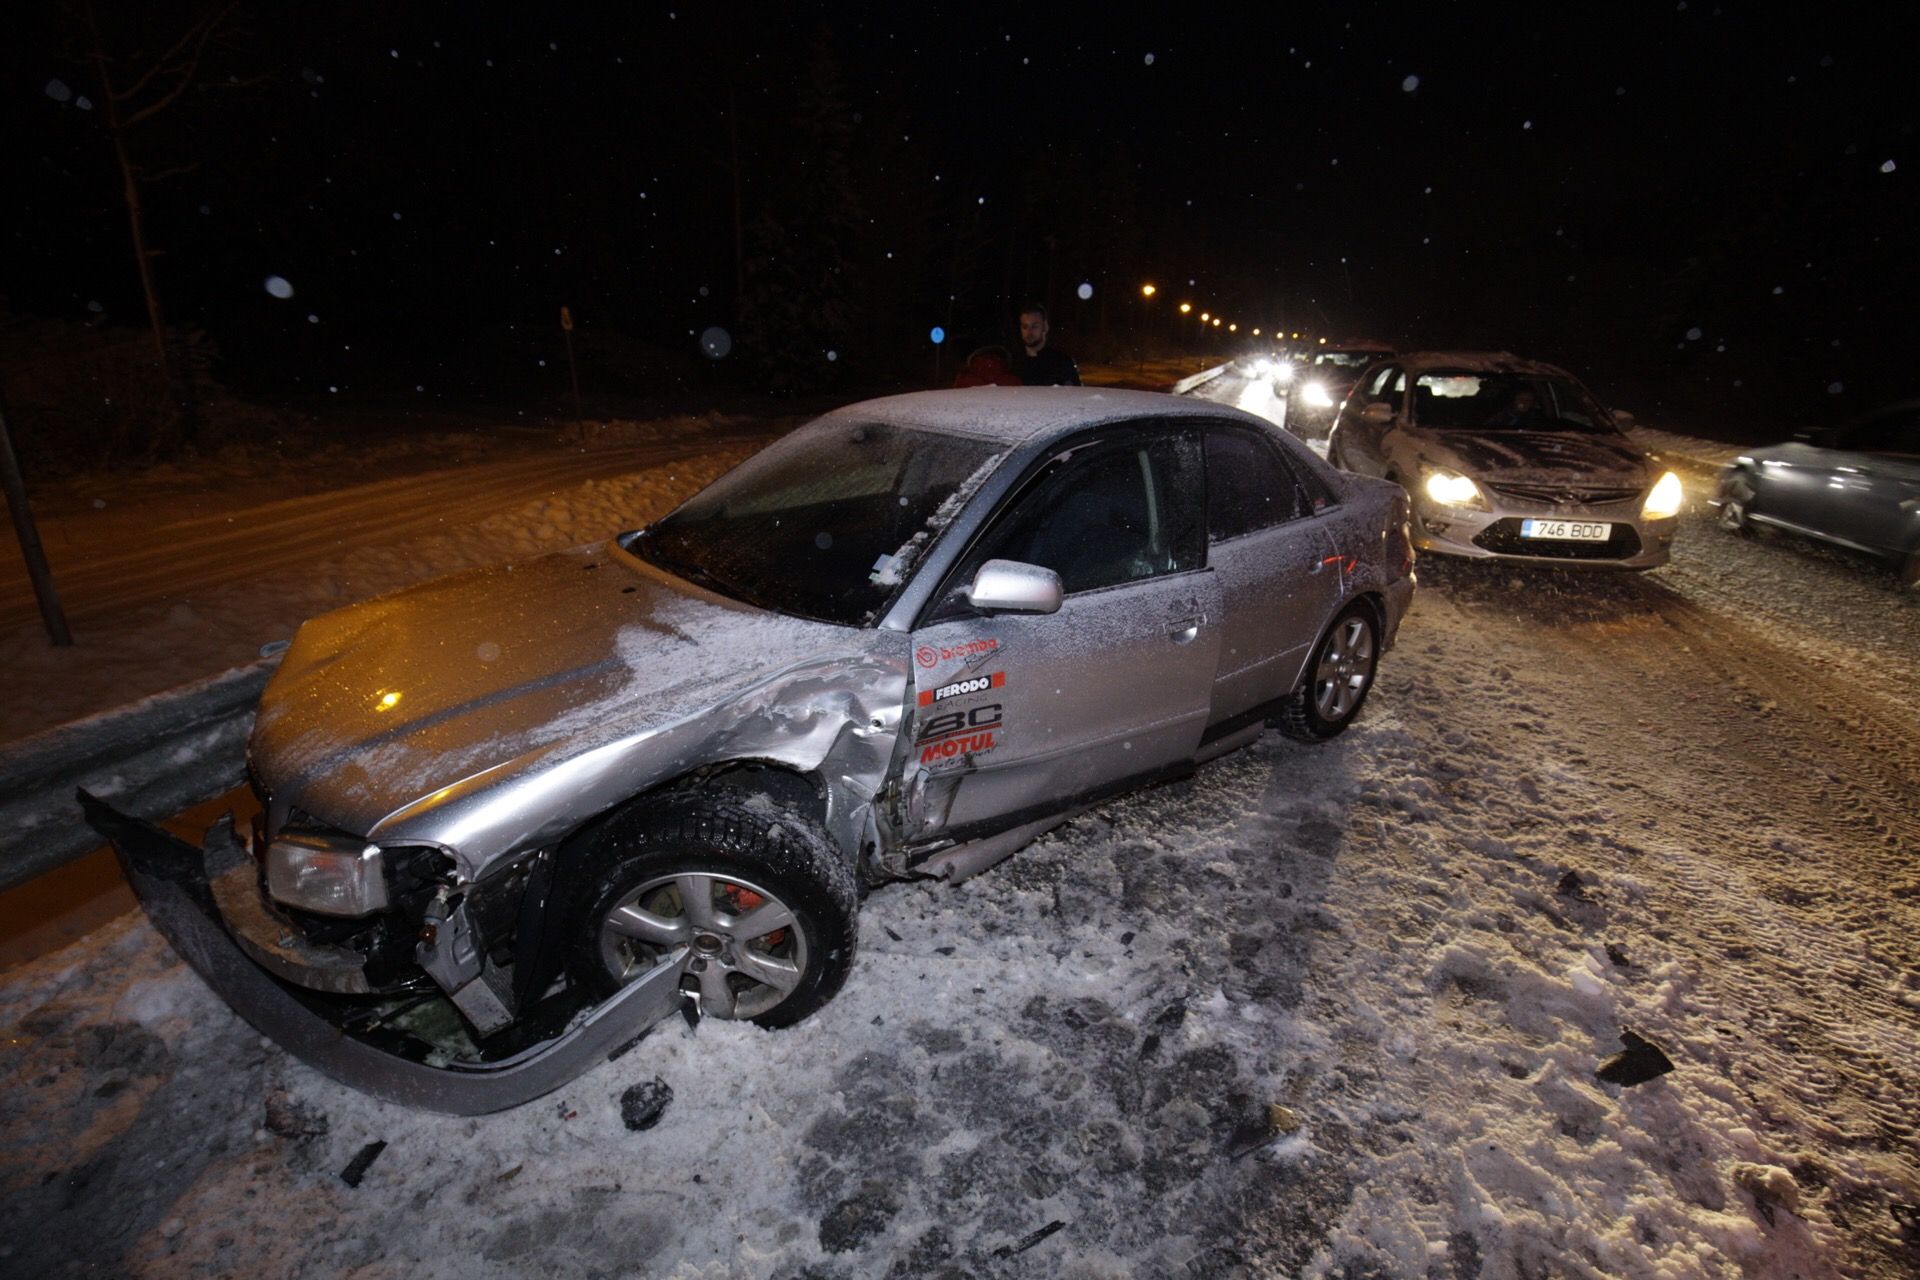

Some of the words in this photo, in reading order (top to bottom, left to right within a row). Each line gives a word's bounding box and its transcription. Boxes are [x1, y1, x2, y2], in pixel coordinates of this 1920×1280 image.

[1538, 523, 1565, 537] 746
[1570, 524, 1604, 538] BDD
[940, 638, 997, 660] brembo
[936, 677, 989, 701] FERODO
[920, 732, 996, 764] MOTUL
